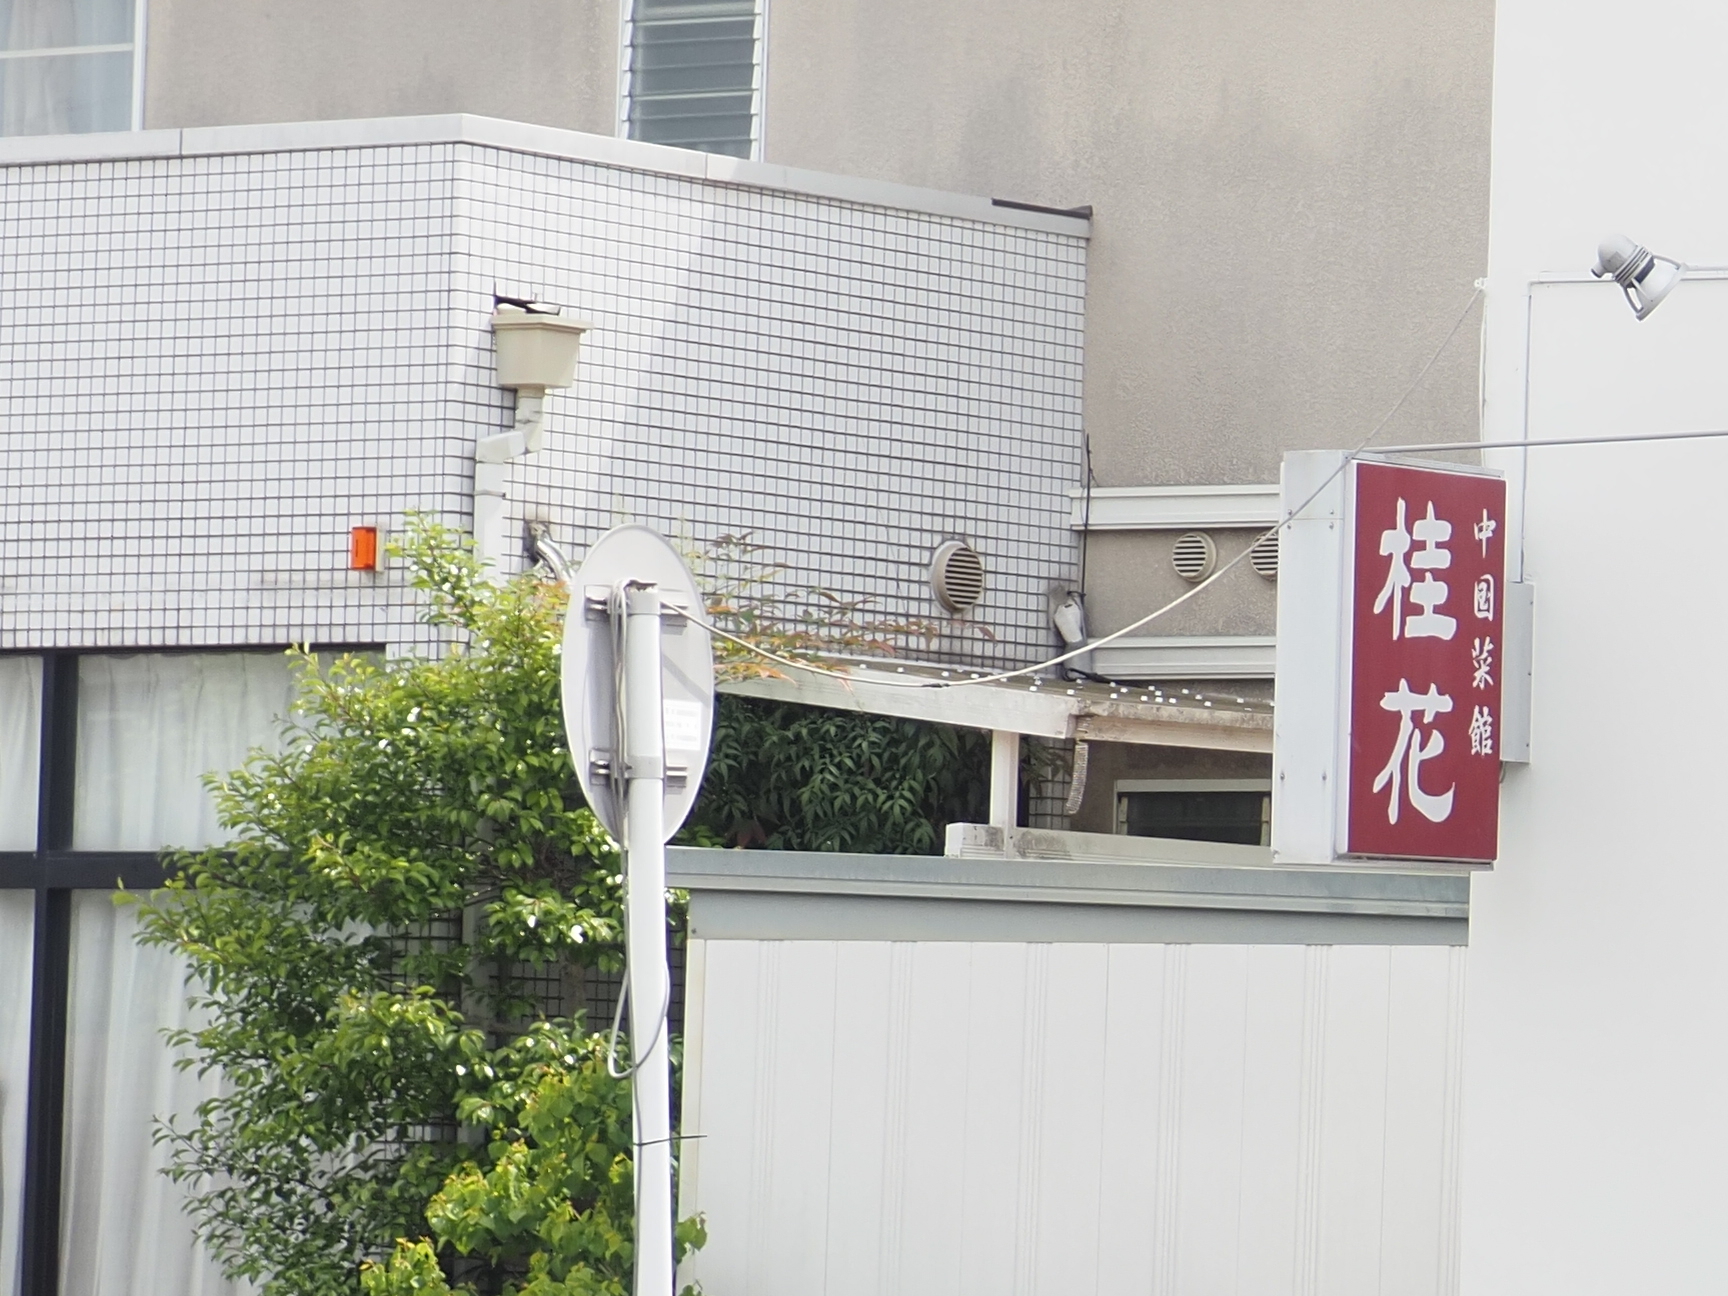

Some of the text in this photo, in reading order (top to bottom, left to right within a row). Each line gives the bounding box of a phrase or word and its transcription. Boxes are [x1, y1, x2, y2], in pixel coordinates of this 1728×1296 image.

[1373, 497, 1457, 824] 桂花
[1468, 508, 1497, 756] 中国菜館
